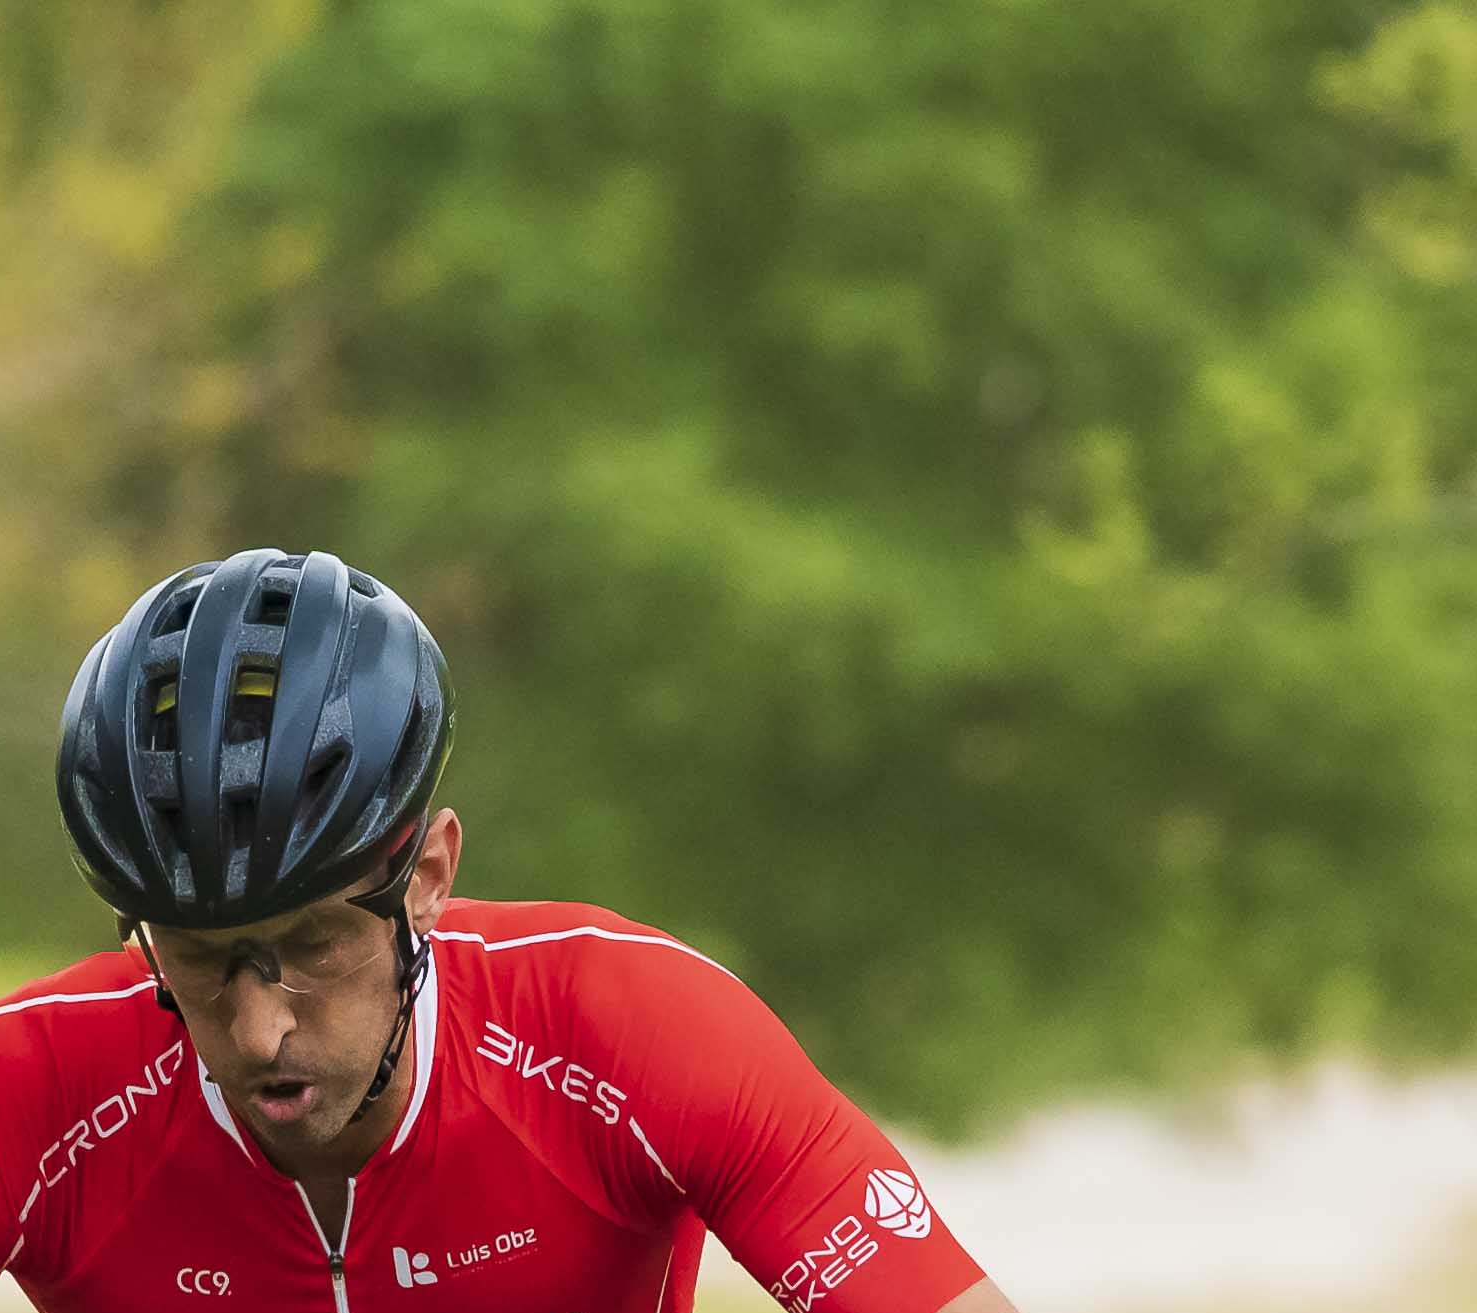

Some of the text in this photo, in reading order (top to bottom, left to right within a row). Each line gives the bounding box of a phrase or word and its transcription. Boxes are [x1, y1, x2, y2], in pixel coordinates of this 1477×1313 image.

[39, 1039, 184, 1188] CRONO
[476, 1021, 627, 1125] BIKES
[446, 1244, 492, 1269] Luis
[495, 1228, 538, 1254] Obz
[770, 1215, 863, 1299] RONO
